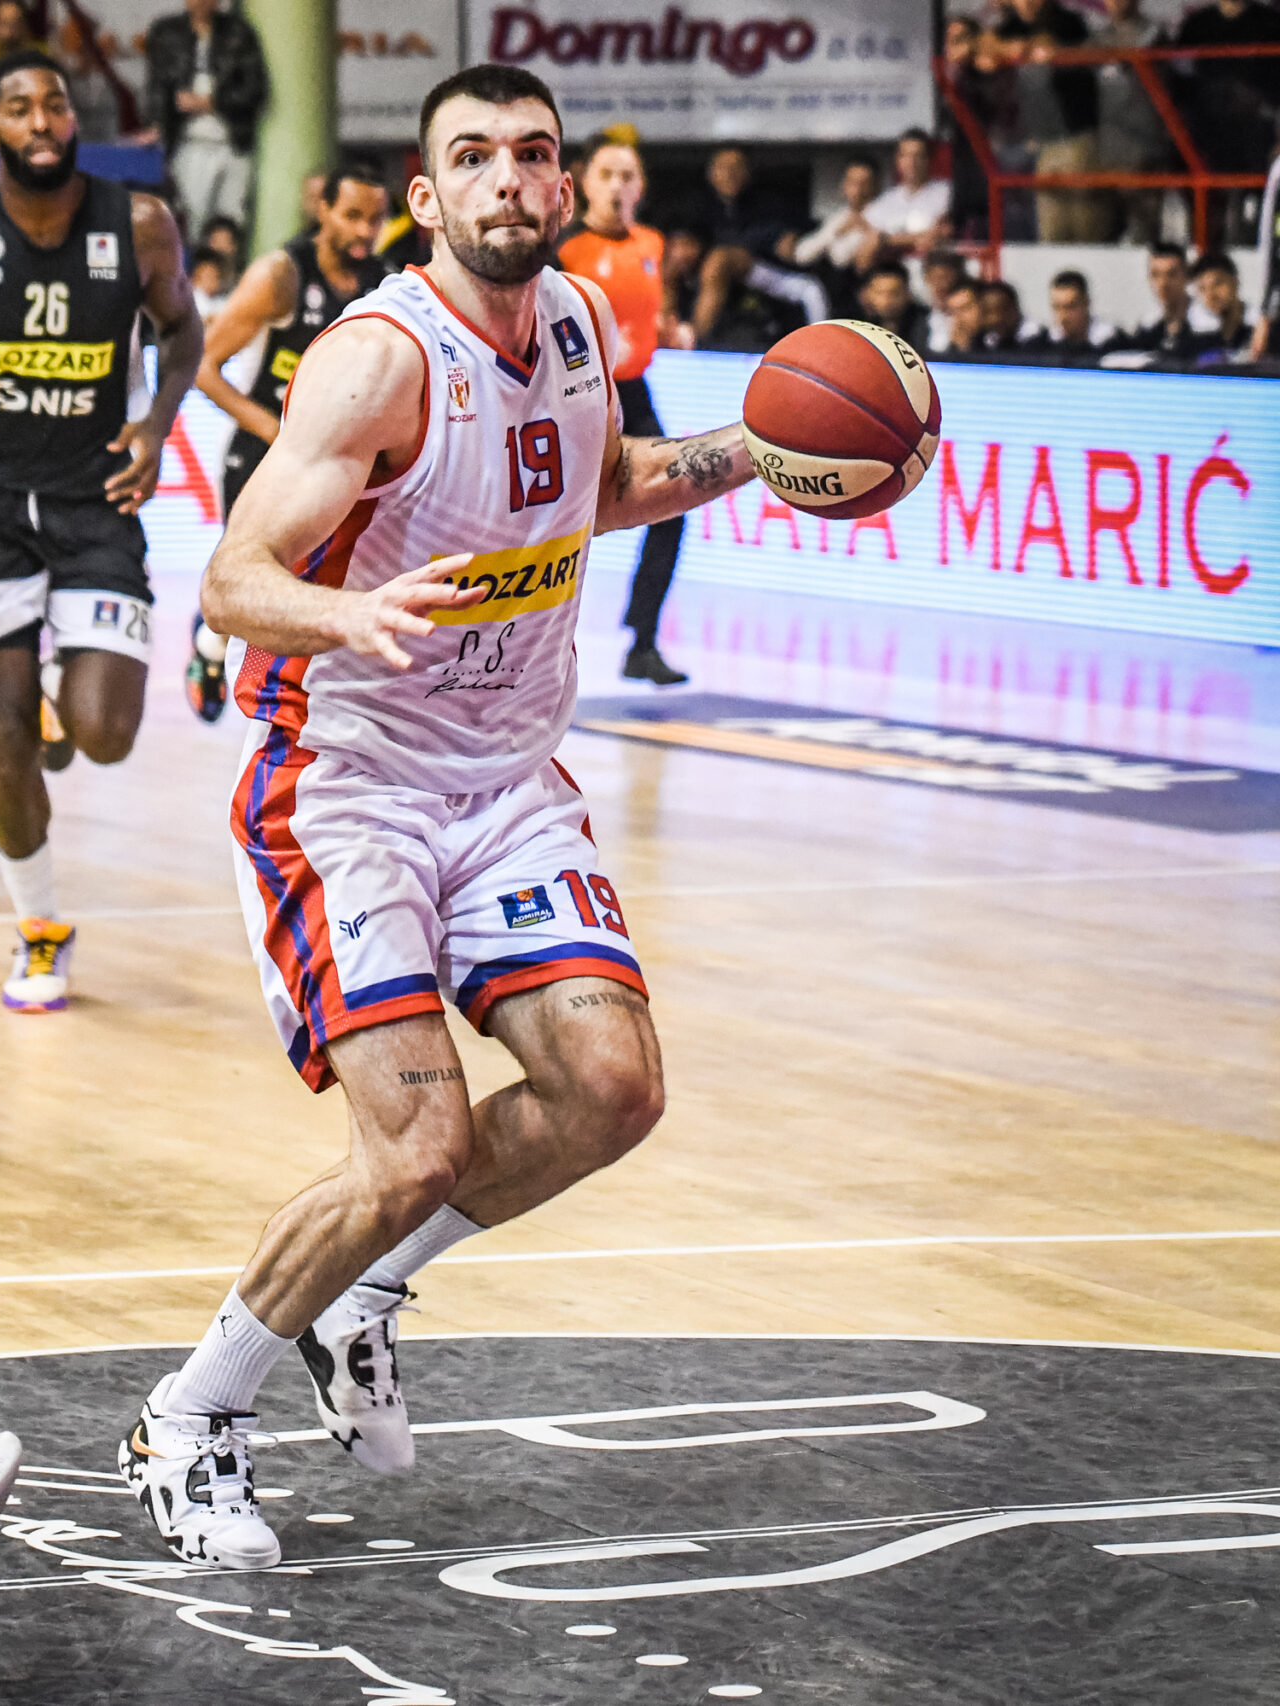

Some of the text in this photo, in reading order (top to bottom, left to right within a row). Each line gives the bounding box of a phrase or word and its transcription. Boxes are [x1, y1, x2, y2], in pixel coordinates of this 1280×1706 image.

[489, 5, 815, 78] Domingo
[89, 268, 117, 280] mts
[24, 282, 69, 337] 26
[31, 388, 96, 416] NIS
[505, 418, 564, 513] 19
[939, 432, 1251, 595] MARIĆ
[125, 603, 149, 644] 26
[554, 869, 630, 941] 19
